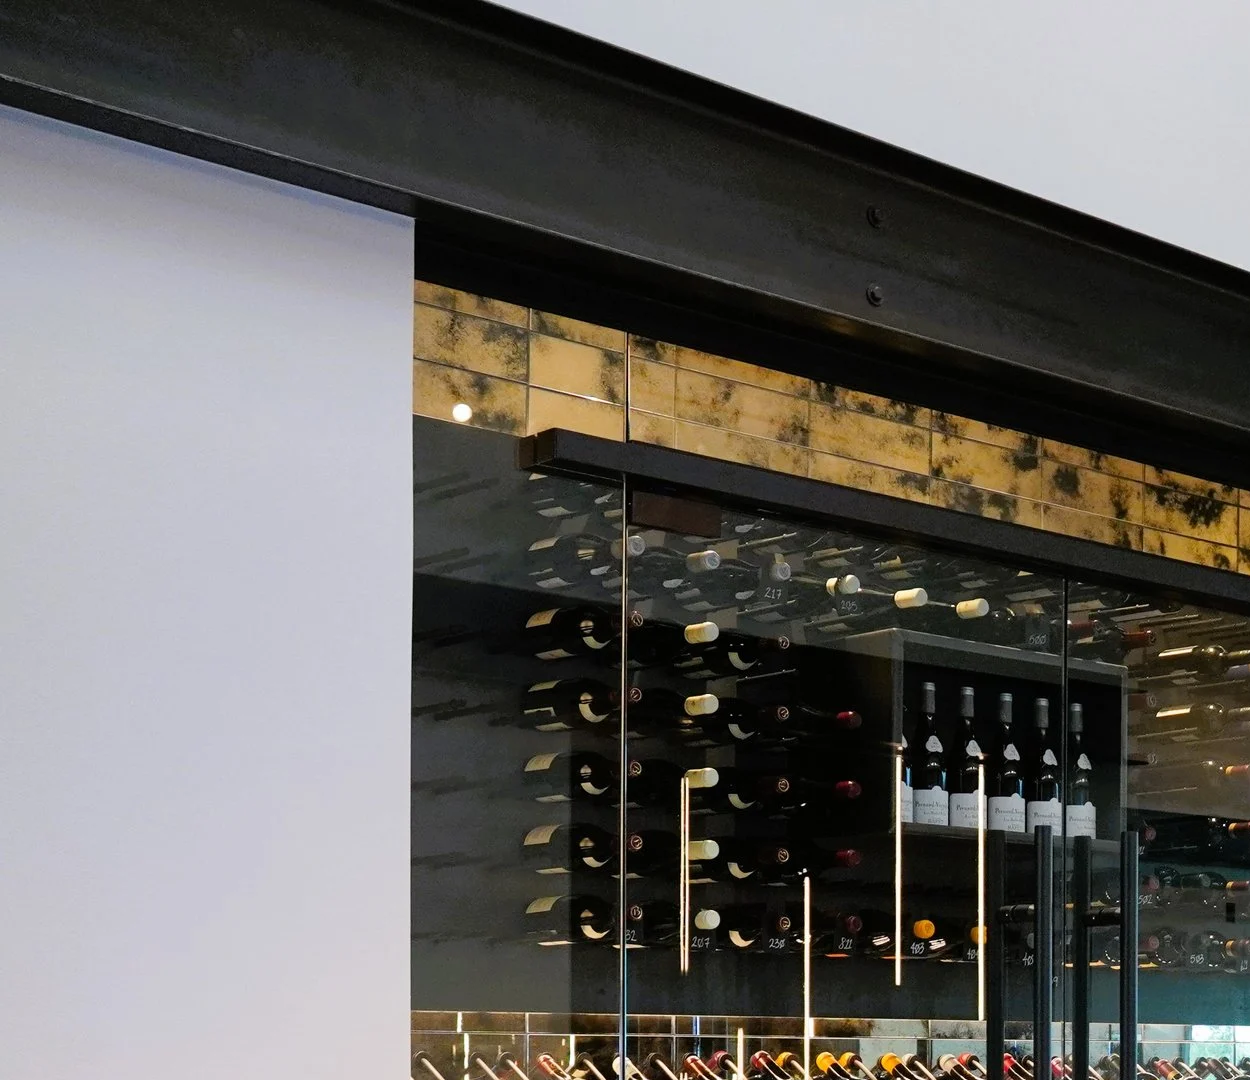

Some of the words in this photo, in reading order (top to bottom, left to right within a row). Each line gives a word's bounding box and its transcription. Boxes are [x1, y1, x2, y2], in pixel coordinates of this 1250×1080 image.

[764, 587, 782, 600] 217
[625, 930, 637, 942] 32
[691, 936, 711, 948] 207
